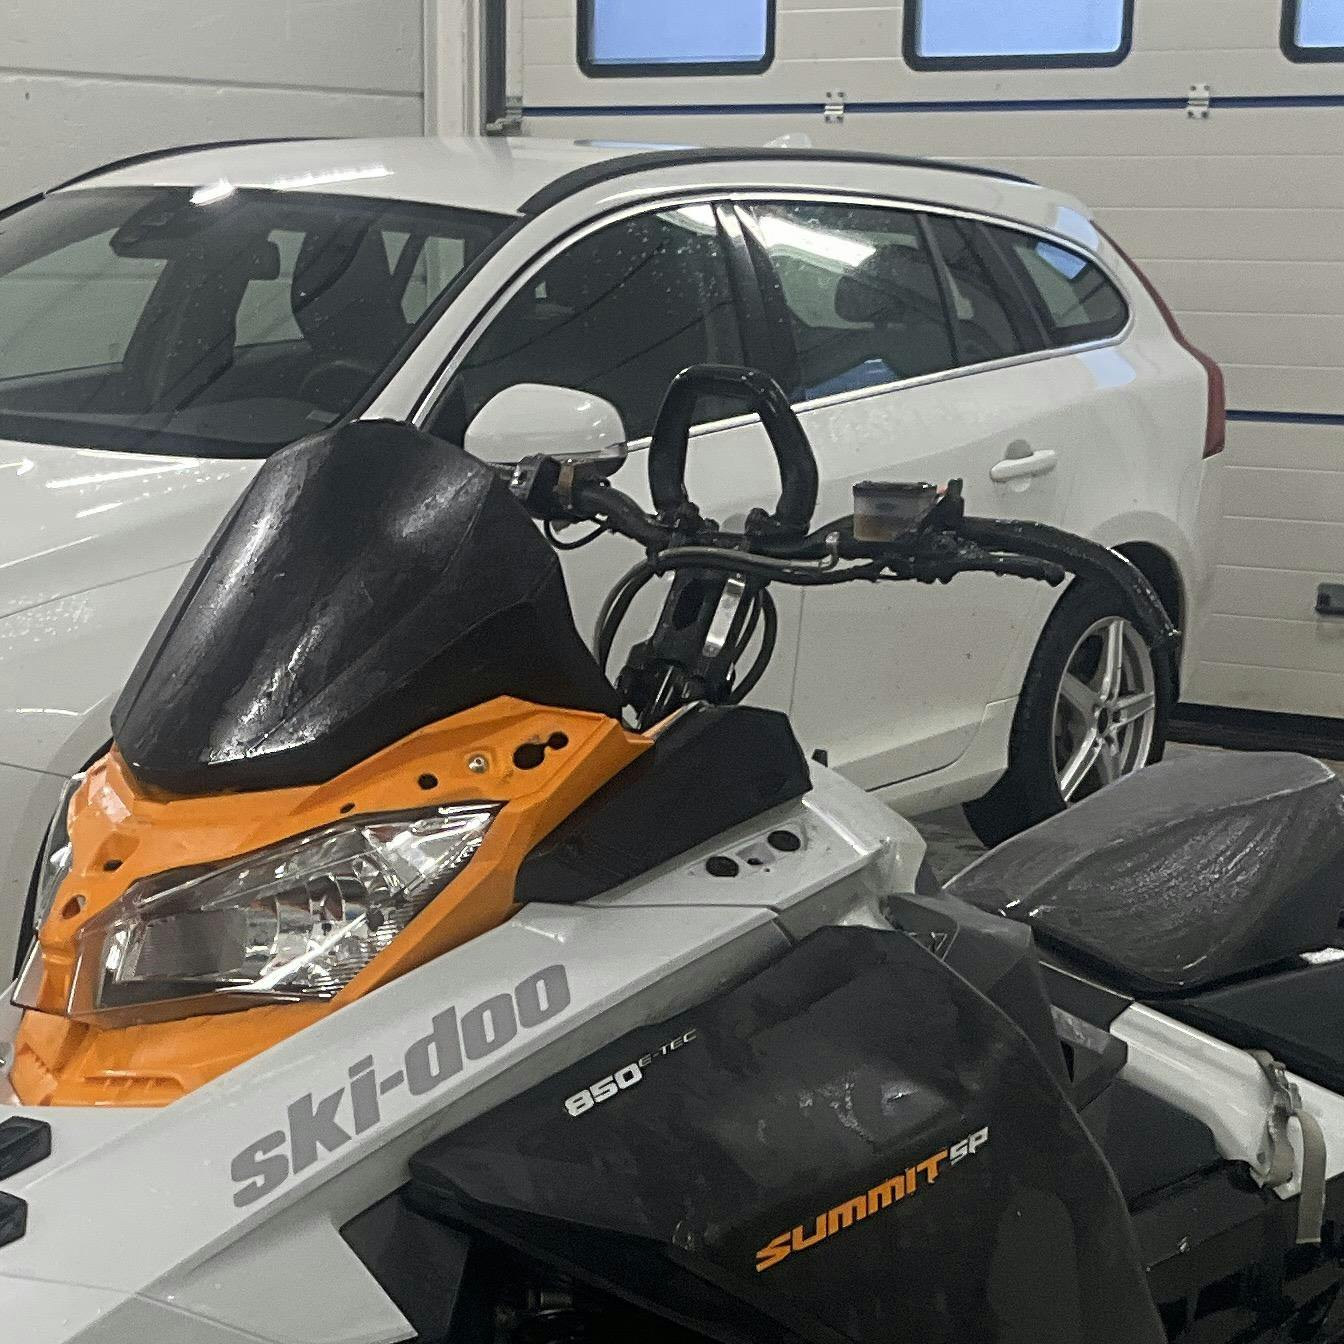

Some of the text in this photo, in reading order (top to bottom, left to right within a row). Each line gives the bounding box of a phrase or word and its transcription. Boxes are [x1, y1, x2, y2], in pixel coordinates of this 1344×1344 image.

[231, 964, 571, 1208] ski-doo
[564, 1028, 697, 1117] 850 E-TEC
[949, 1126, 989, 1166] SP
